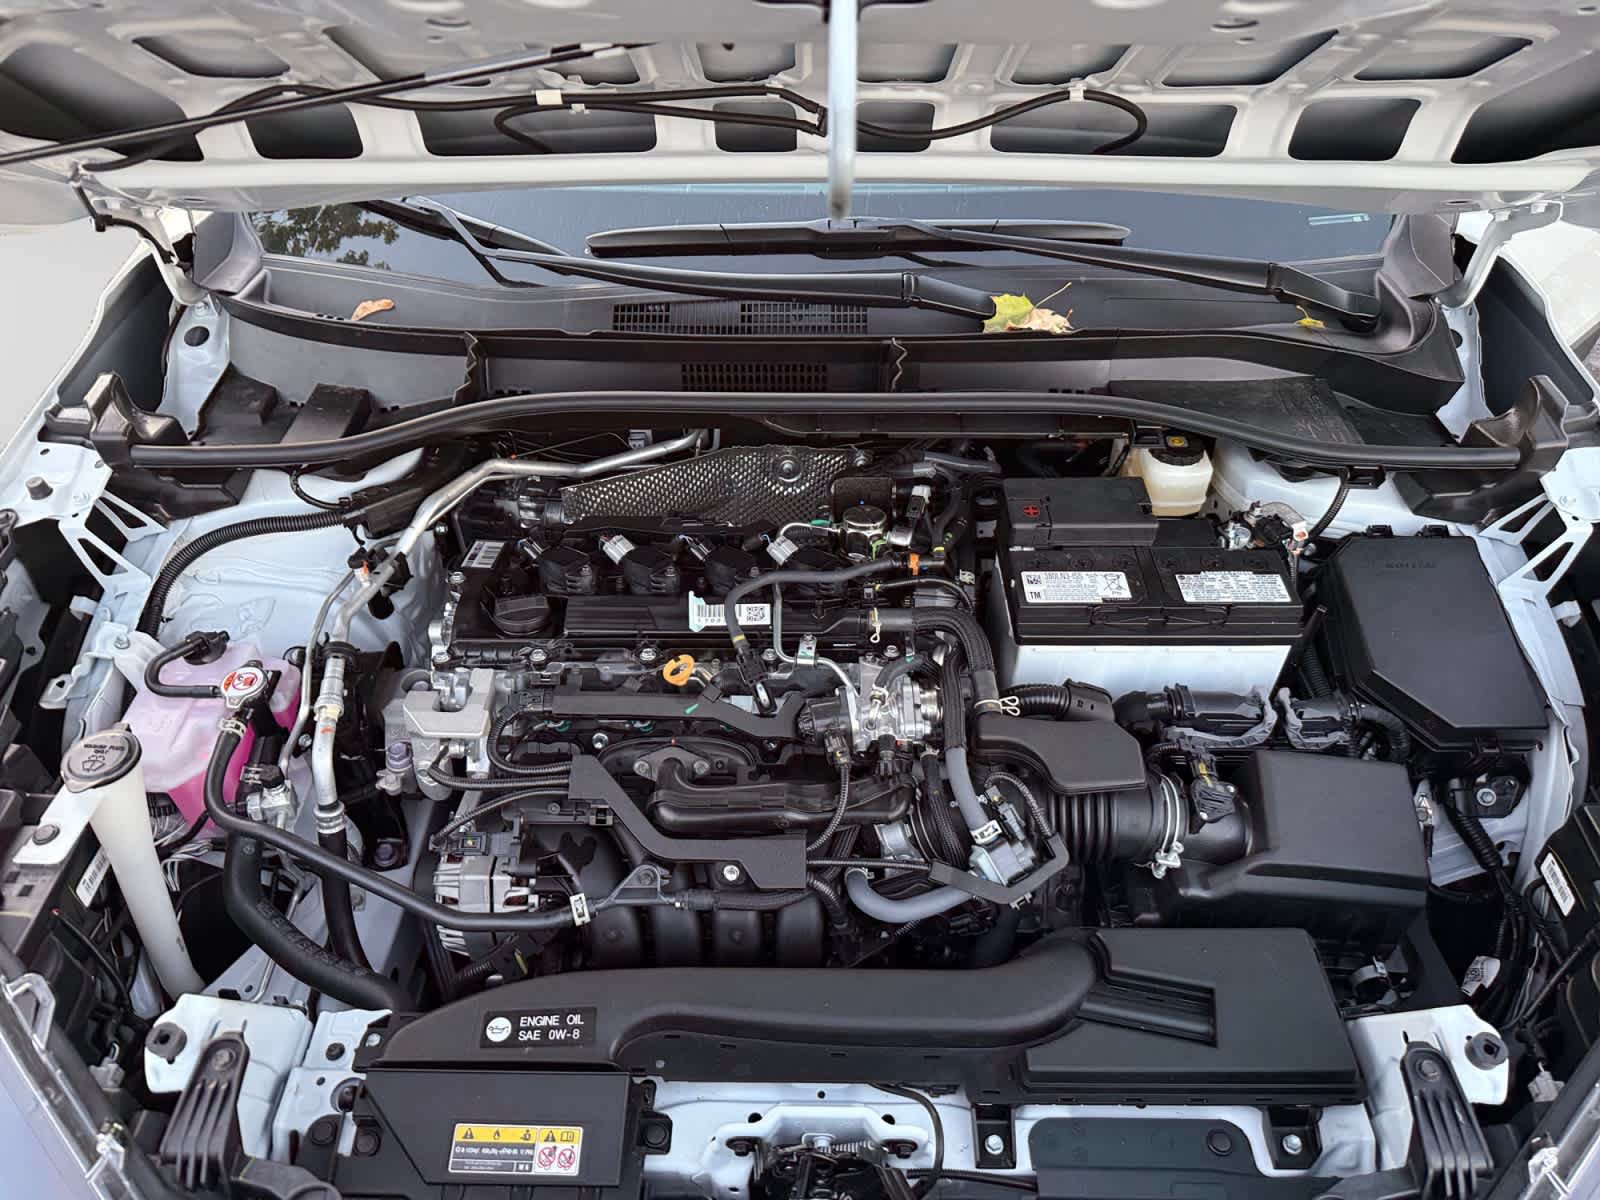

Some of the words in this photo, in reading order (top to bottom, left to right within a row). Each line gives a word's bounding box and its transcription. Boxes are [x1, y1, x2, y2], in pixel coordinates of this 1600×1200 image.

[519, 1016, 560, 1027] ENGINE
[566, 1014, 584, 1025] OIL
[518, 1030, 541, 1041] SAE
[548, 1029, 580, 1040] 0W-8
